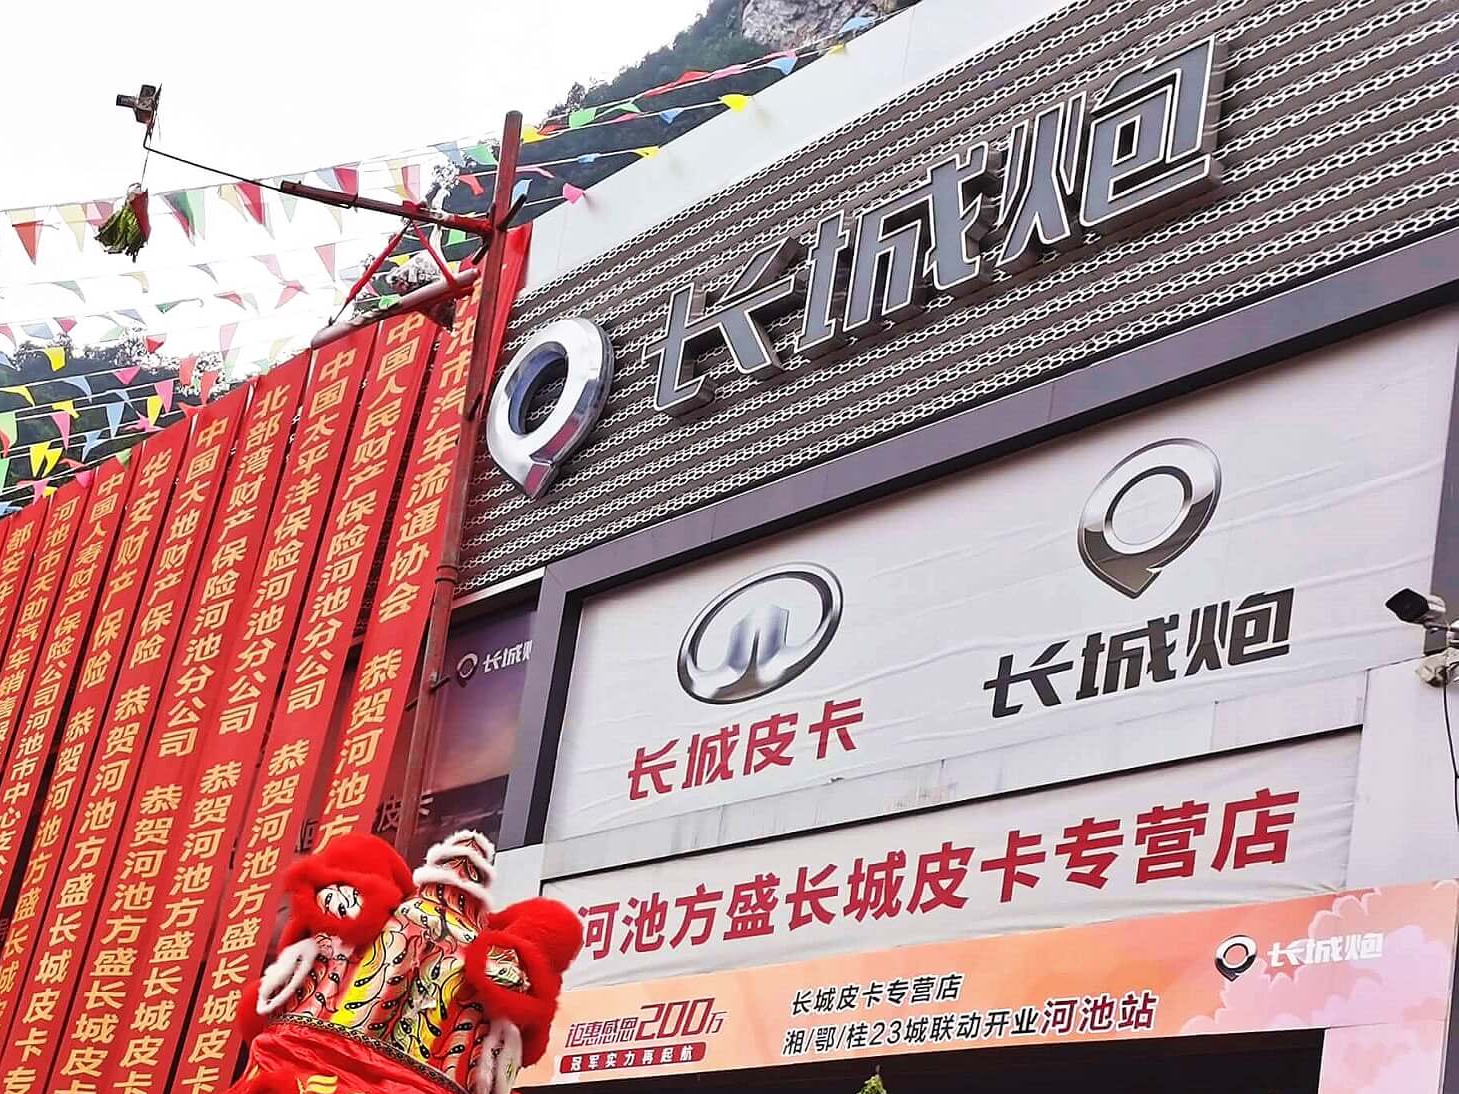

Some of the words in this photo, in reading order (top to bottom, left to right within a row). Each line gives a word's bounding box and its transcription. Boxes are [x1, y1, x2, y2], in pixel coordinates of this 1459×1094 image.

[645, 33, 1226, 413] 长城炮
[81, 451, 171, 688] 华安财产保险
[130, 419, 227, 666] 中国大地财产保险
[160, 387, 287, 756] 北部湾财产保险河池分公司
[220, 352, 354, 733] 中国太平洋保险河池分公司
[288, 315, 423, 711] 中国人民财产保险河池分公司
[627, 698, 865, 802] 长城皮卡
[982, 587, 1295, 718] 长城炮
[578, 788, 1301, 962] 河池方盛长城皮卡专营店
[1266, 931, 1384, 968] 长城炮
[569, 1044, 694, 1072] 冠军实力再起航
[791, 972, 963, 1017] 长城皮卡专营店
